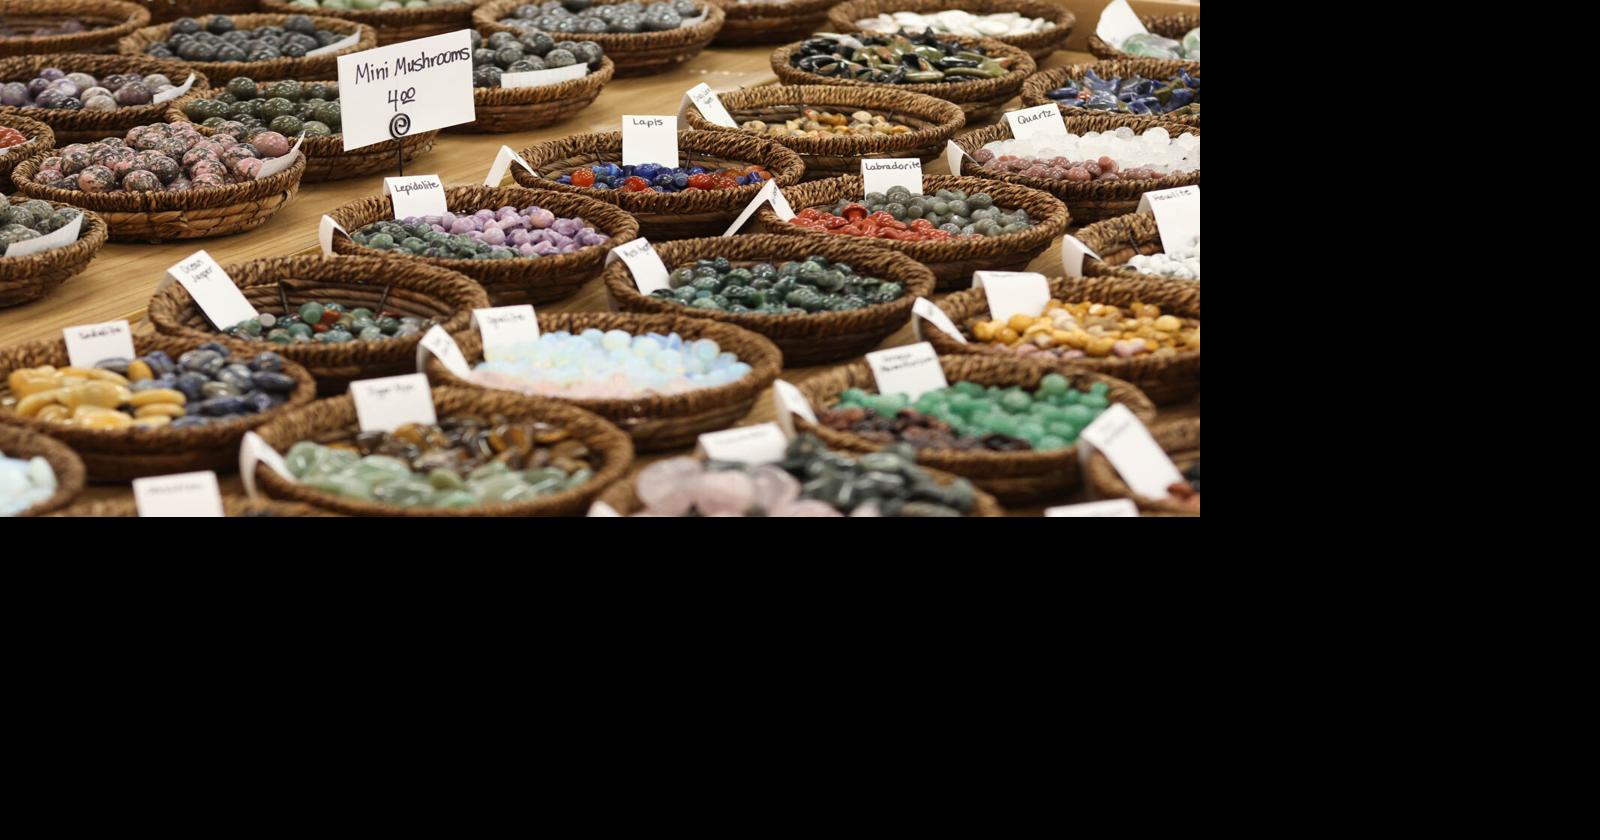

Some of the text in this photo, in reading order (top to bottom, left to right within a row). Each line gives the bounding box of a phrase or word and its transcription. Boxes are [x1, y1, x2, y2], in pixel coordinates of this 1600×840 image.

[355, 47, 471, 85] Mini Mushrooms
[633, 118, 664, 128] Lapis
[1017, 109, 1056, 125] Quartz
[865, 161, 921, 172] Labradorite
[394, 180, 440, 196] Lepidolite
